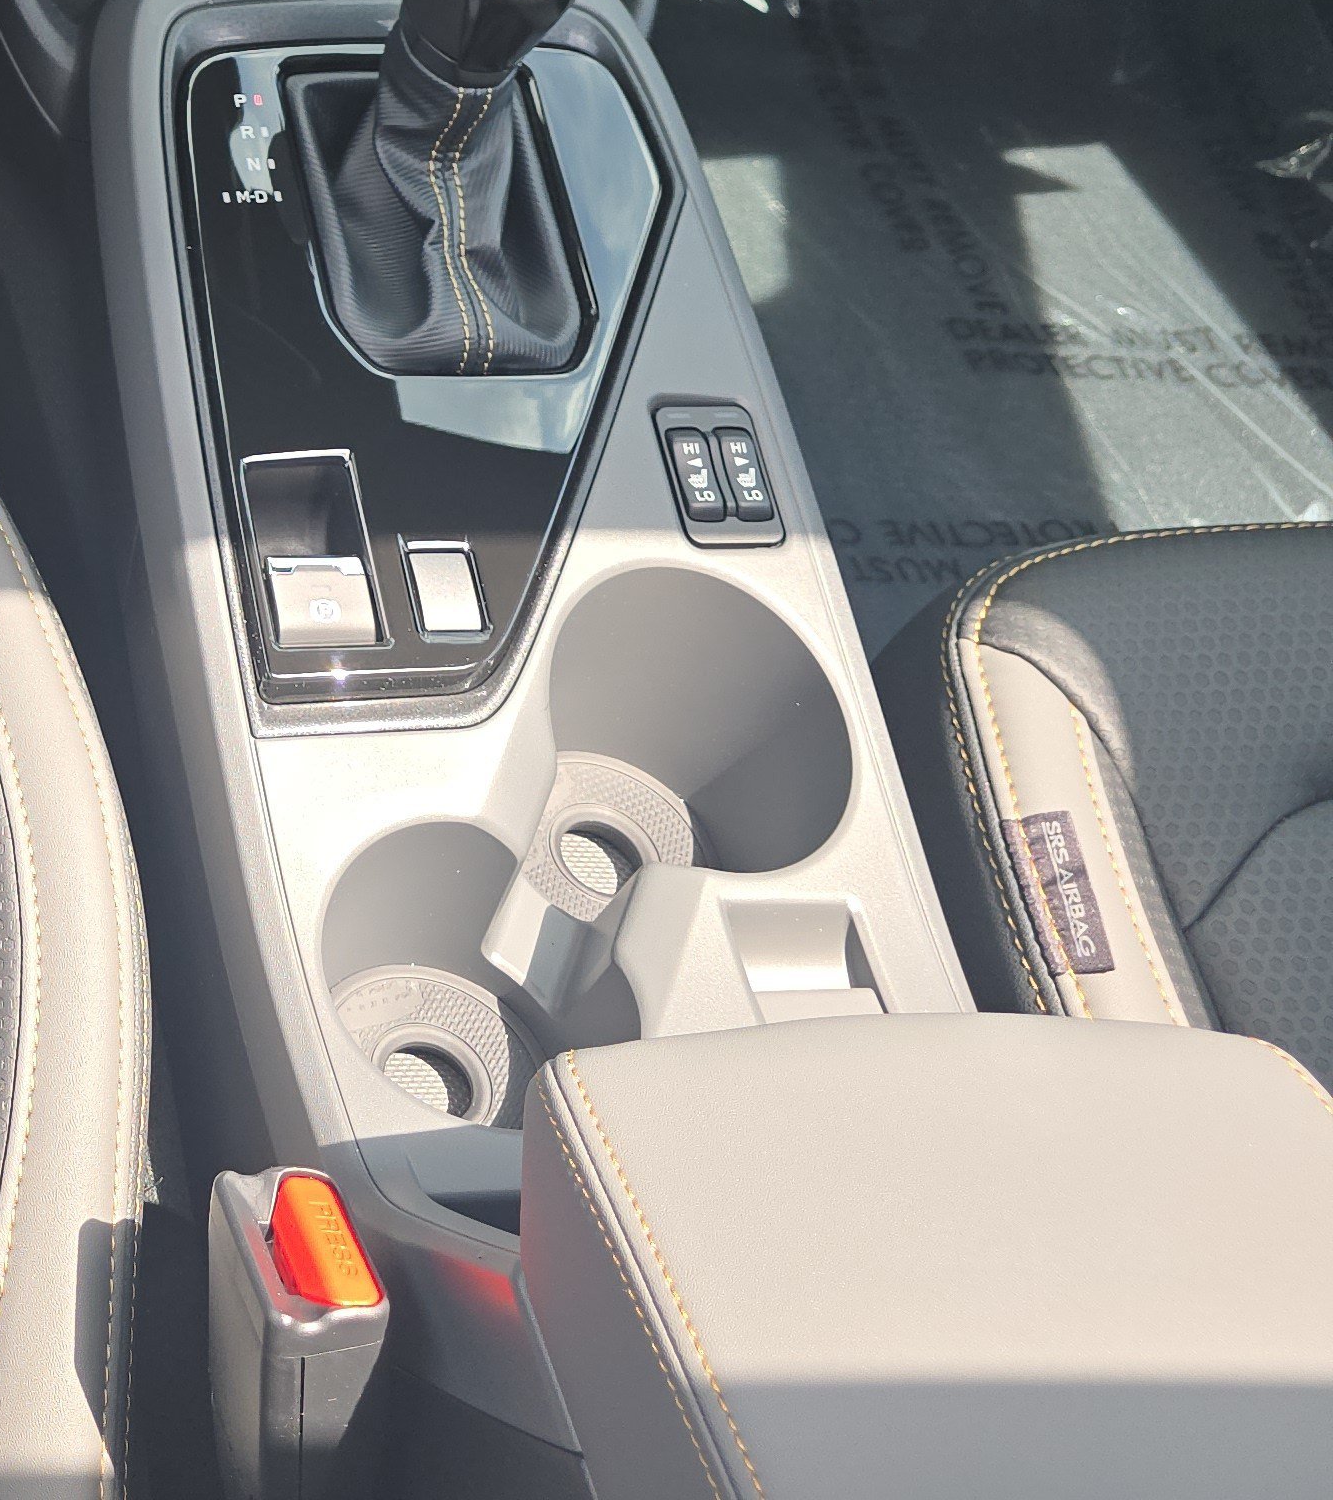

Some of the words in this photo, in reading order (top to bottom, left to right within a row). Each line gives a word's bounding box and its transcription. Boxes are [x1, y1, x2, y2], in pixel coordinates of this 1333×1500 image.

[233, 93, 247, 108] P
[240, 125, 256, 140] R
[245, 157, 262, 171] N
[682, 442, 700, 455] HI
[729, 442, 748, 454] HI
[694, 490, 716, 502] LO
[743, 489, 764, 501] LO
[850, 556, 962, 584] MUST
[1044, 819, 1071, 866] SRS
[1058, 872, 1097, 959] AIRBAG
[307, 1199, 359, 1278] PRESS
